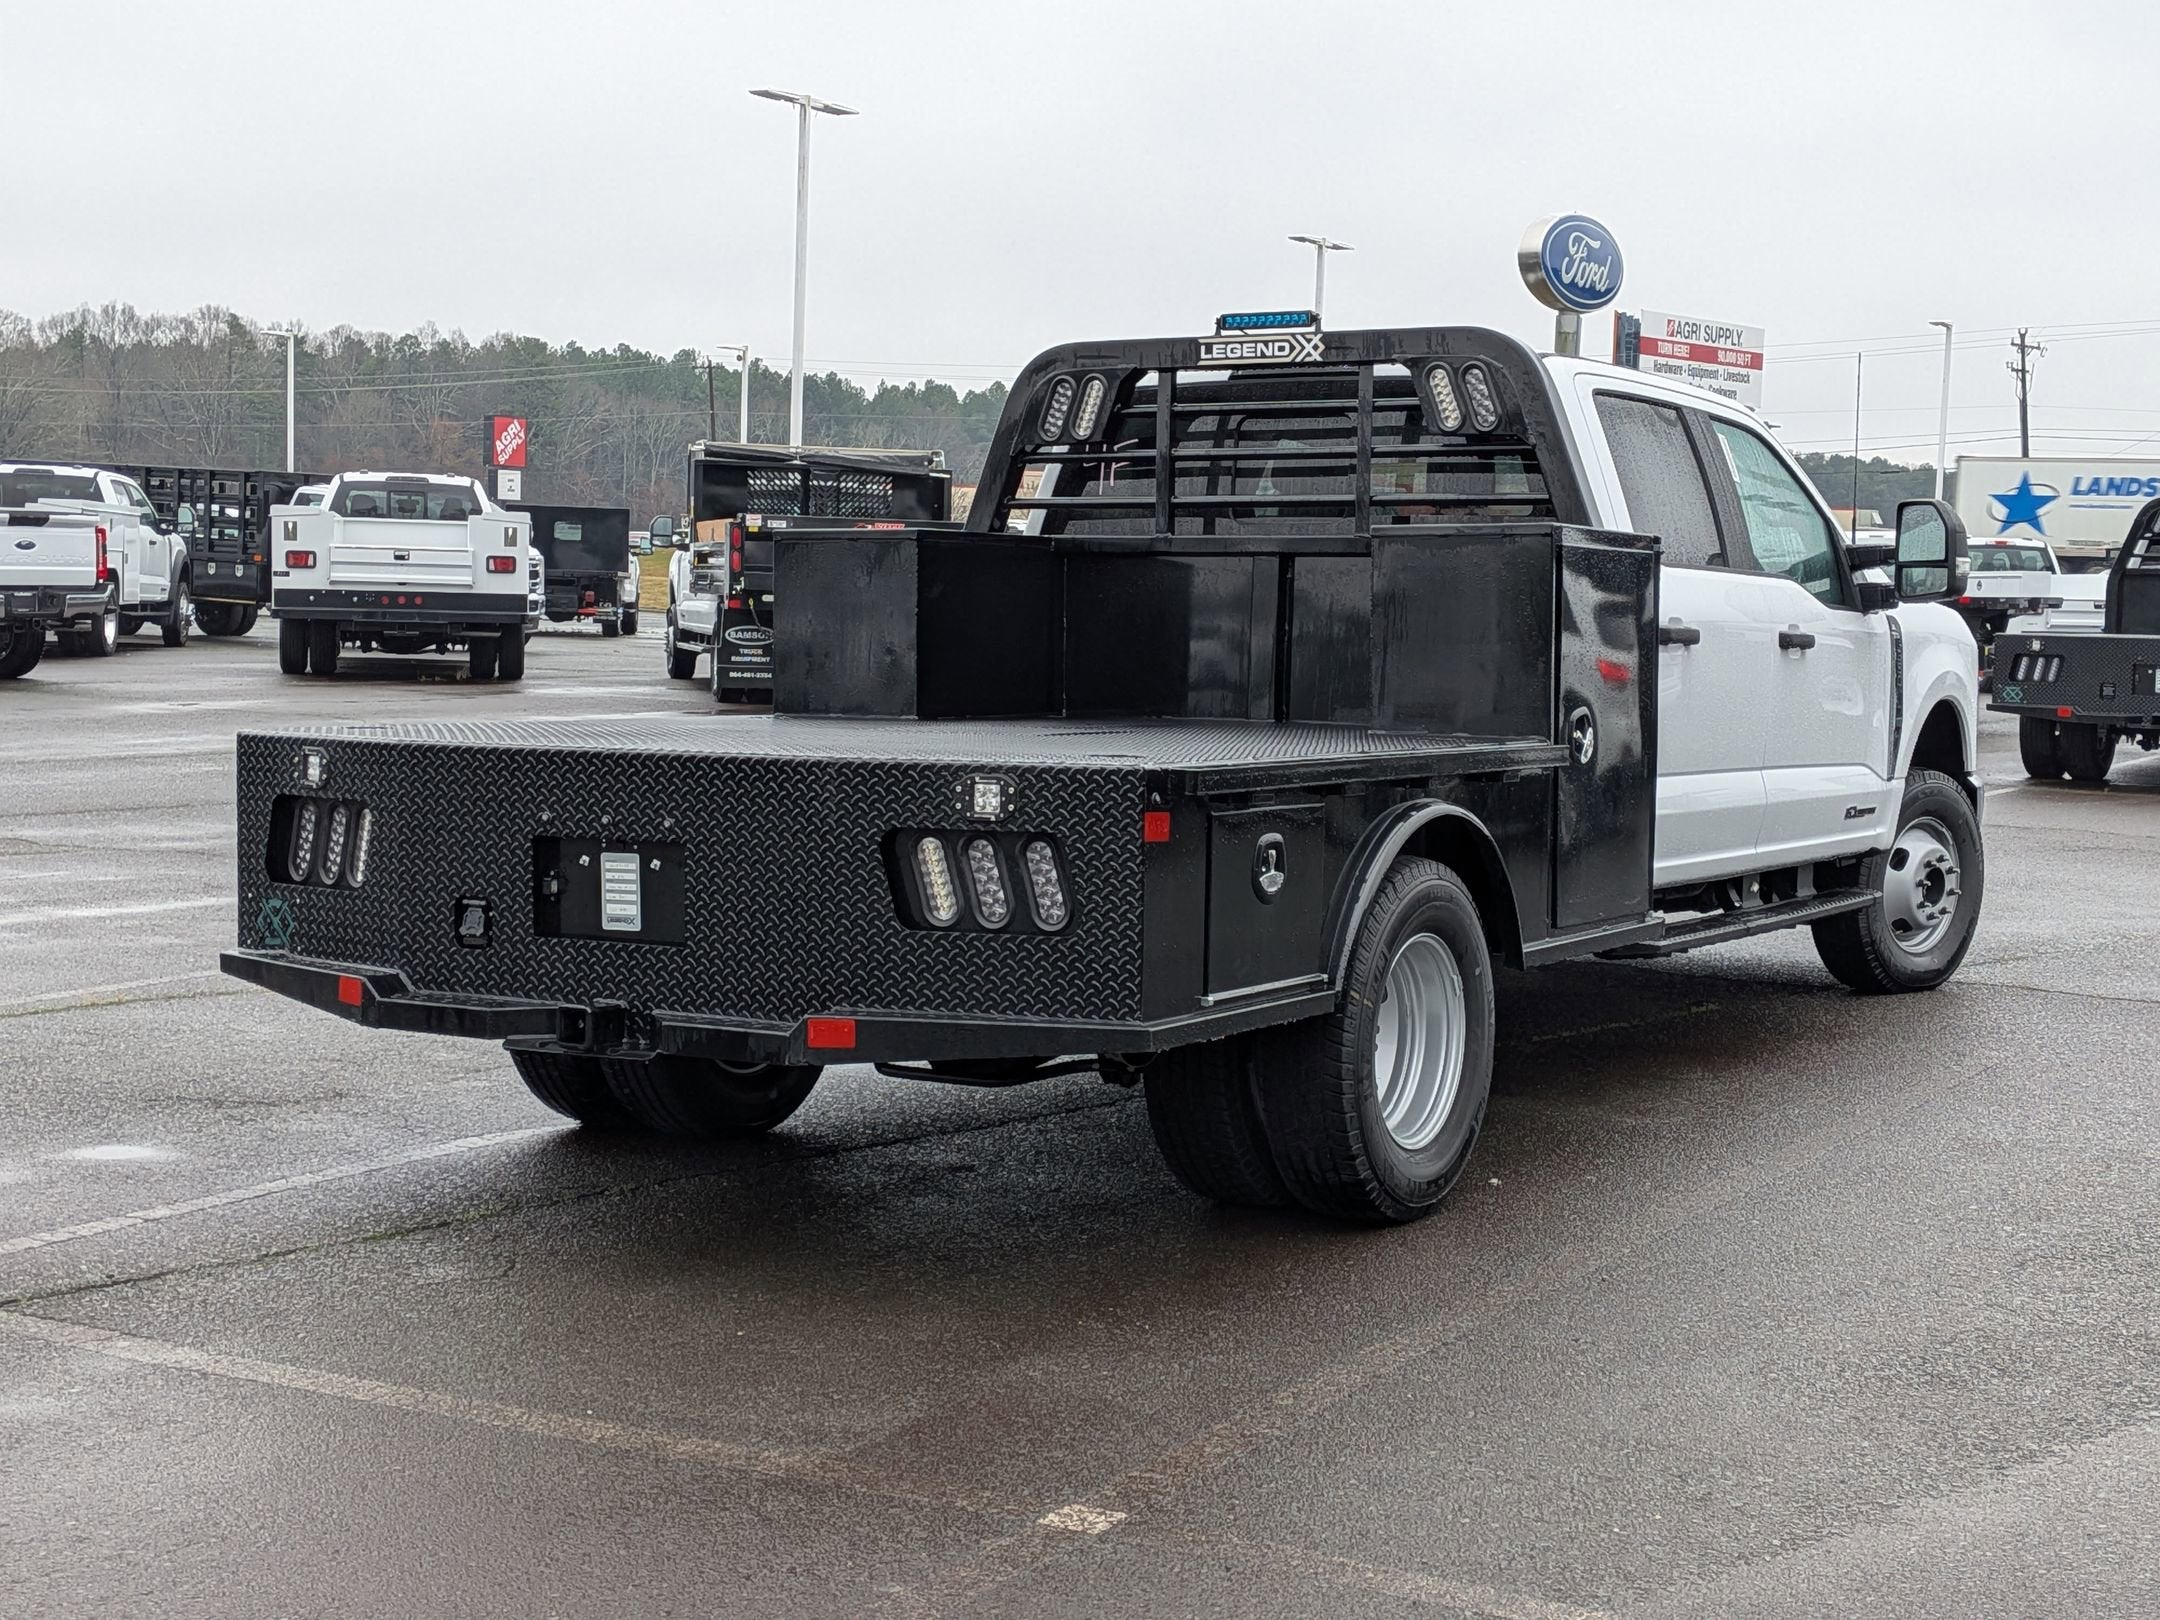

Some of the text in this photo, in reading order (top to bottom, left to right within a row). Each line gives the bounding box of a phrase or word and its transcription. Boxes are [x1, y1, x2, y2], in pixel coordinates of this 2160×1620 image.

[1562, 232, 1612, 292] Ford
[1674, 320, 1743, 347] AGRI SUPPLY
[1653, 359, 1751, 385] Hardware Equipment Livestock
[495, 419, 522, 455] AGRI
[497, 428, 526, 465] SUPPLY
